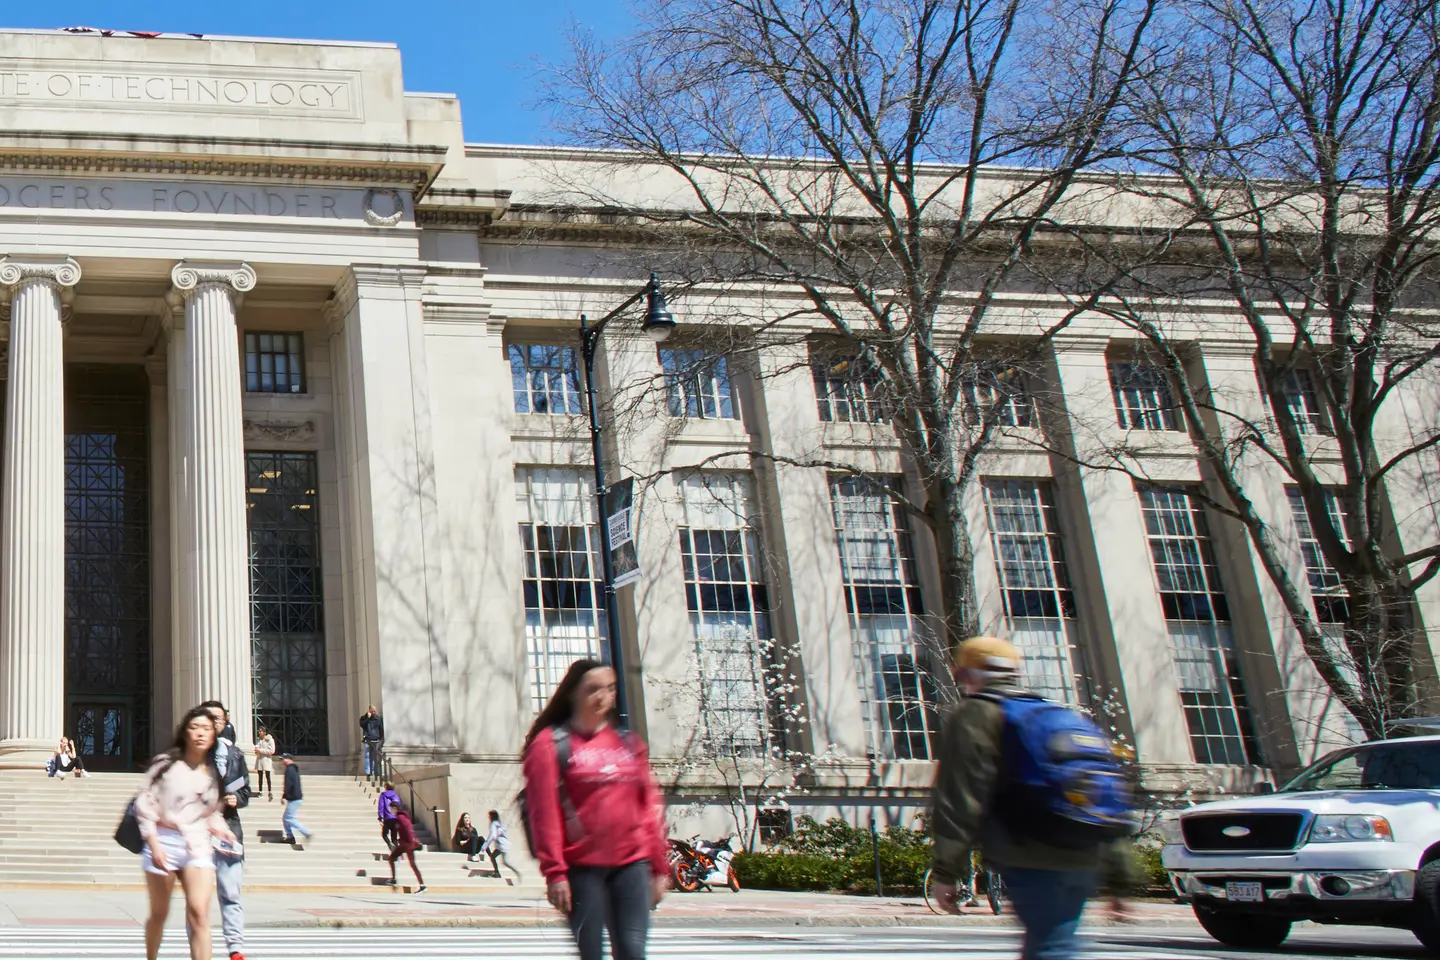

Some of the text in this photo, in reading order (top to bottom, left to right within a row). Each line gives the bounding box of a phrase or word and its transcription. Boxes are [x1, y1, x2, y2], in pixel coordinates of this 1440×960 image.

[47, 73, 91, 98] OF
[103, 75, 343, 108] TECHNOLOGY
[152, 187, 342, 219] FOVNDER
[610, 521, 626, 538] SCIENCE
